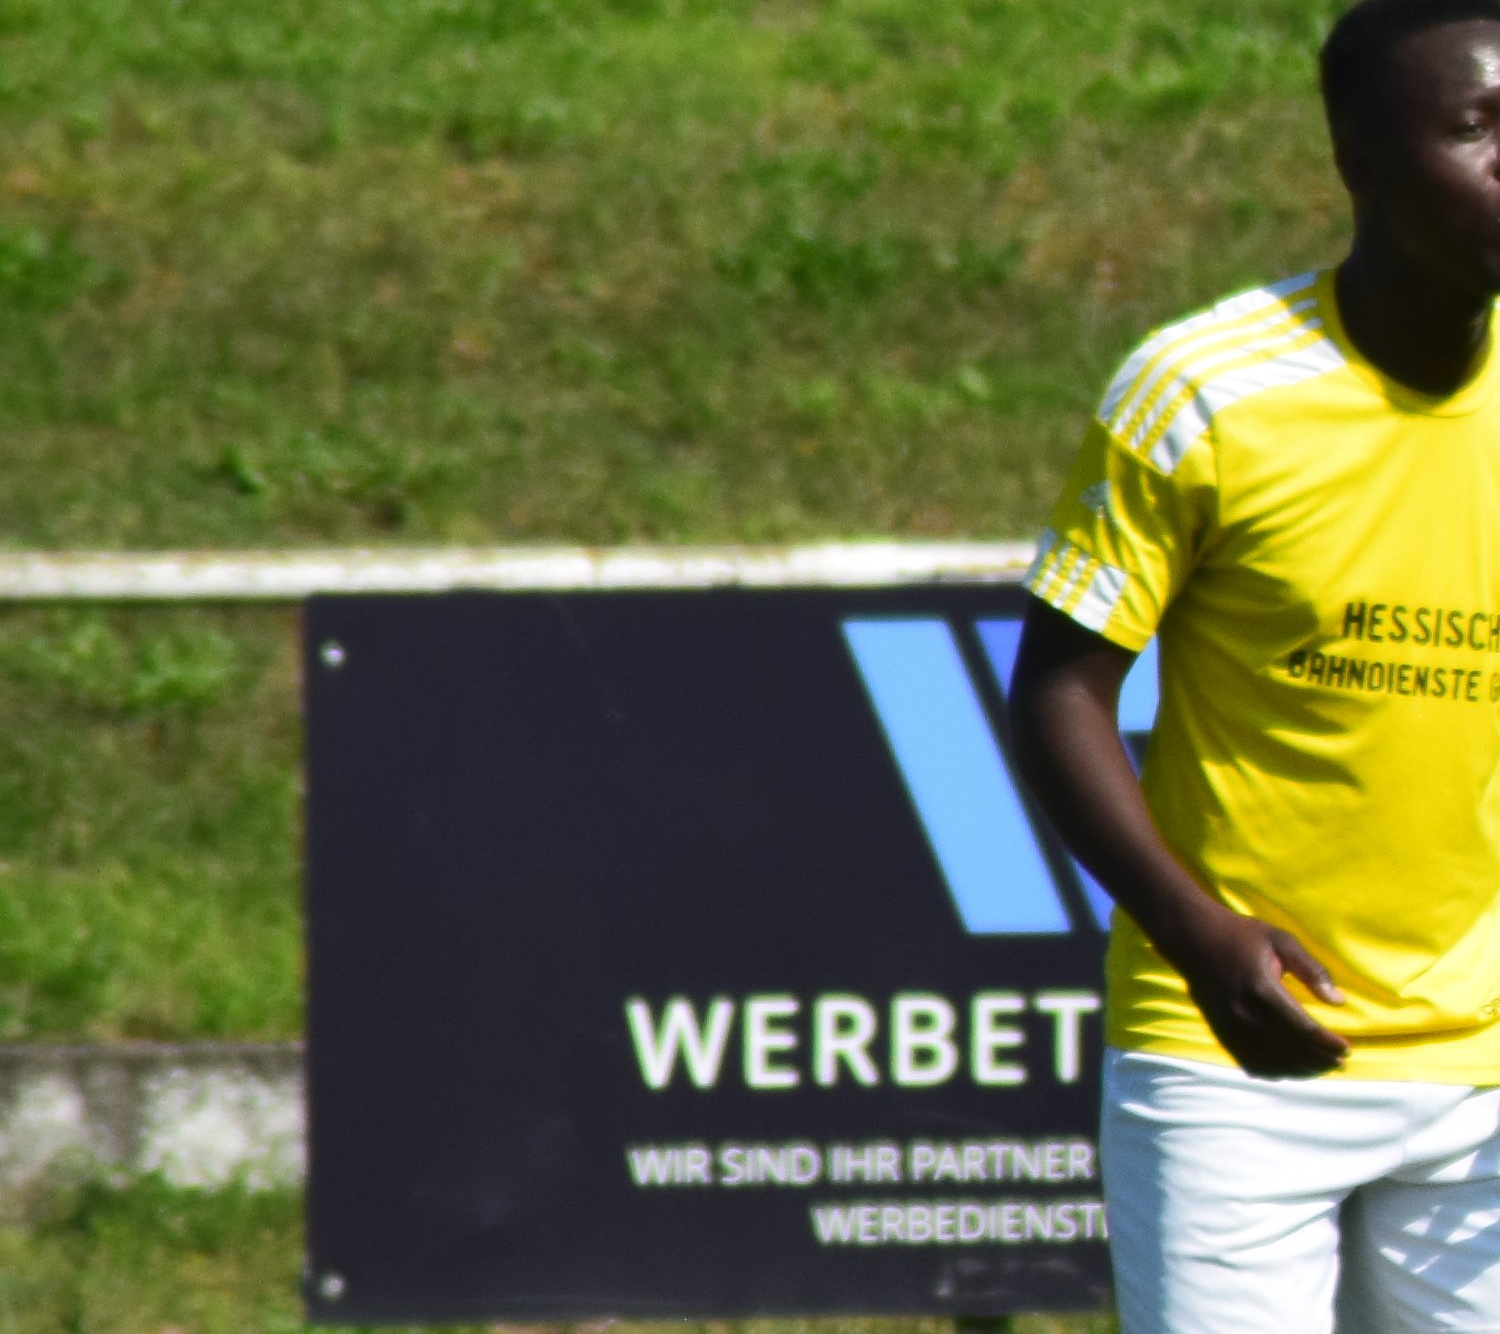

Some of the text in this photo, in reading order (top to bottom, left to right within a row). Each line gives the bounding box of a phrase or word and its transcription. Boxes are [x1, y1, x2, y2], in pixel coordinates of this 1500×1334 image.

[1286, 650, 1482, 702] BAHNDIENSTE
[626, 993, 1102, 1089] WERBET
[628, 1139, 1095, 1186] WIR SIND IHR PARTNER
